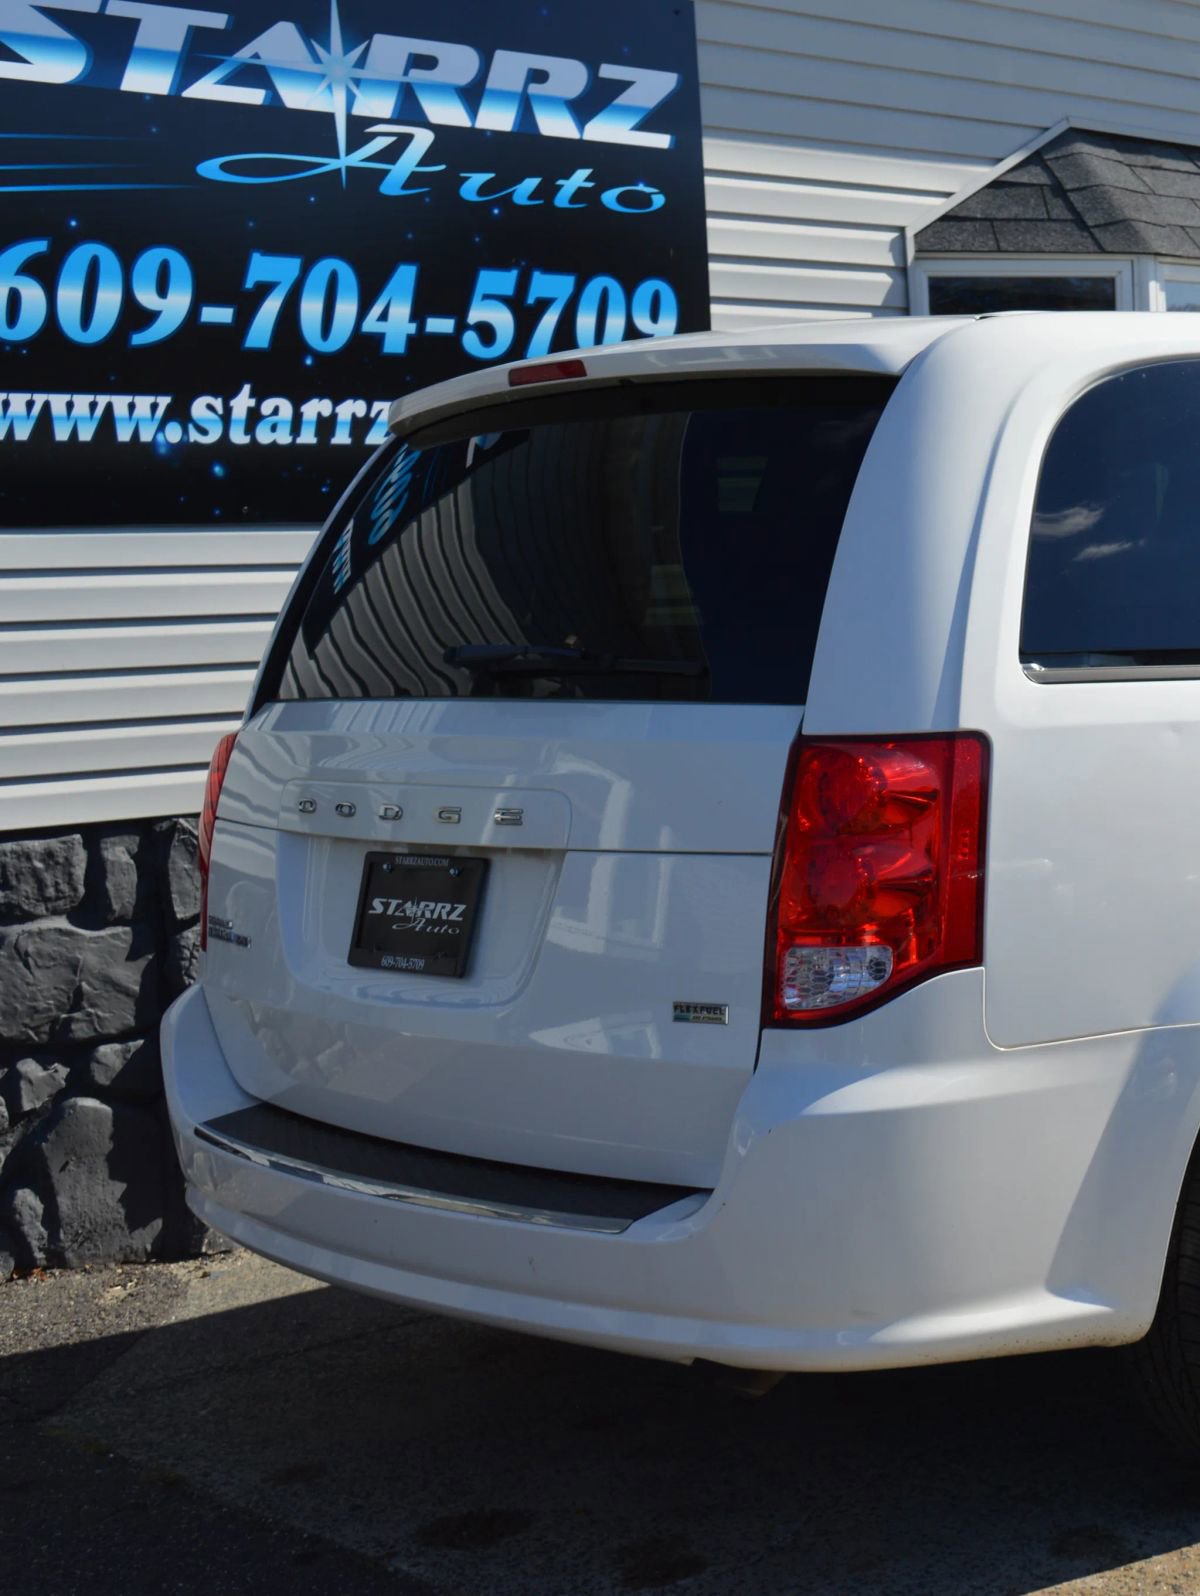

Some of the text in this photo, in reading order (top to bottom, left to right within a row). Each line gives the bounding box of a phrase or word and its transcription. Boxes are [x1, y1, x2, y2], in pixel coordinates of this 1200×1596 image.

[0, 0, 682, 149] STARRZ
[195, 123, 666, 214] Auto
[0, 238, 680, 360] 609-704-5709
[298, 798, 524, 826] DODGE
[367, 897, 467, 921] STARRZ
[391, 917, 460, 935] Auto
